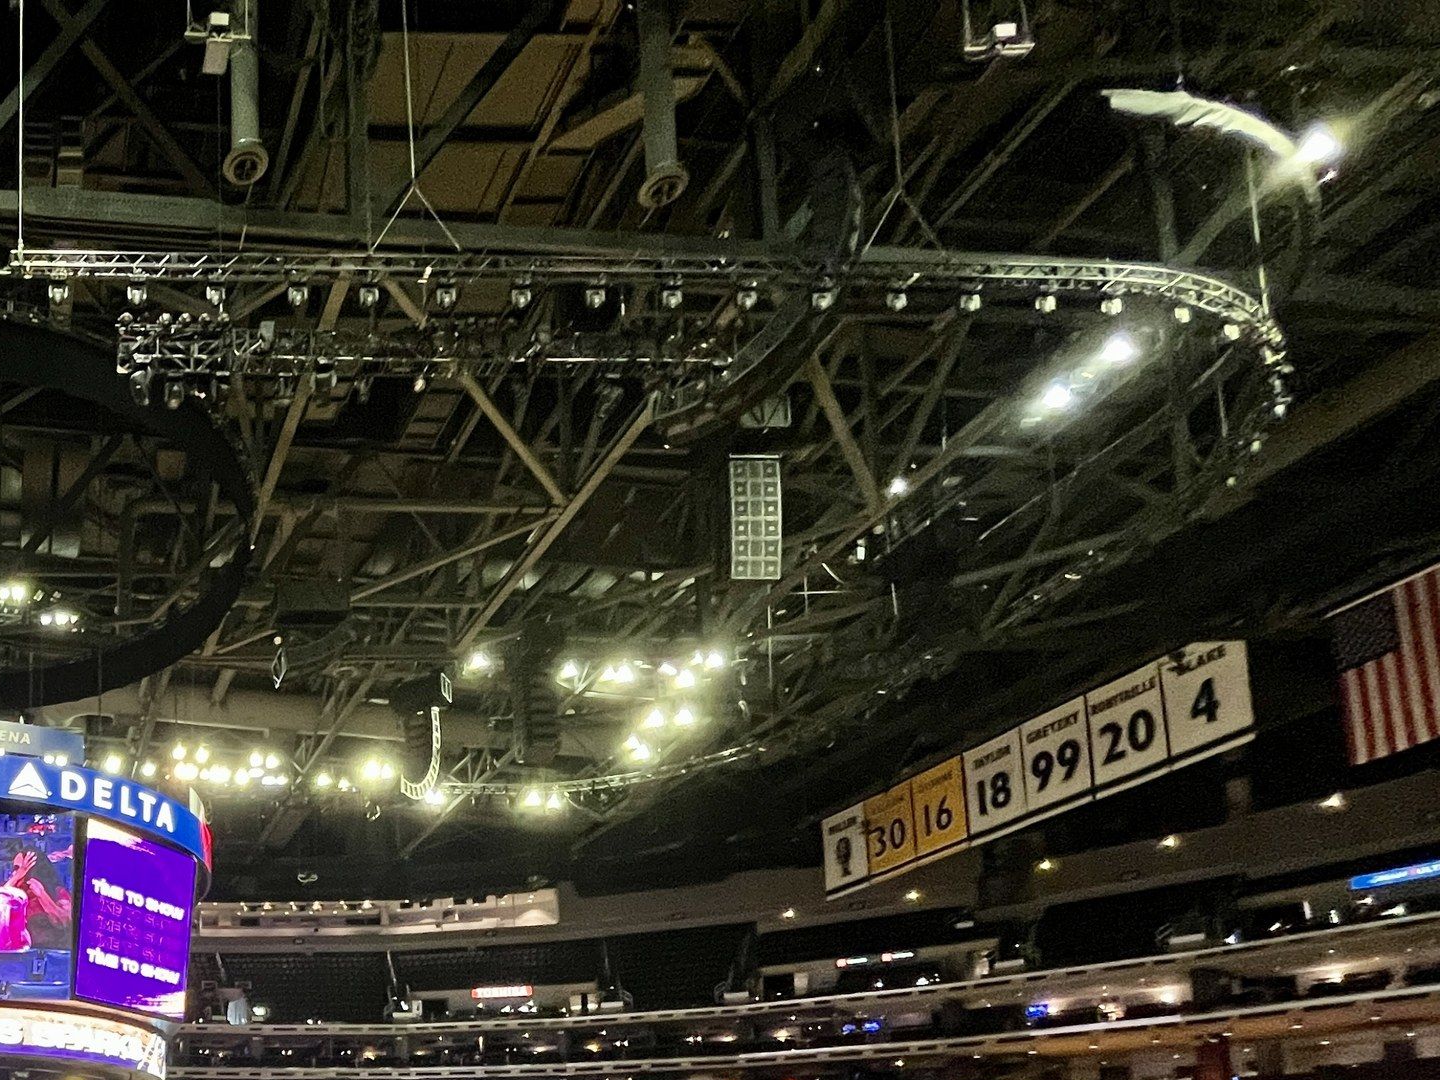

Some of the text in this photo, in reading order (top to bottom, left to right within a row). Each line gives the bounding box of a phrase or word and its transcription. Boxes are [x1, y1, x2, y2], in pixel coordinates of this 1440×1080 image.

[1190, 677, 1221, 725] 4
[1098, 708, 1156, 766] 20
[1031, 738, 1081, 793] 99
[61, 770, 175, 834] DELTA
[923, 794, 953, 837] 16
[977, 771, 1012, 816] 18
[867, 818, 906, 858] 30
[91, 878, 185, 921] TIME TO SHOW
[86, 946, 180, 985] TIME TO SHOW
[32, 1022, 144, 1063] SPARKS
